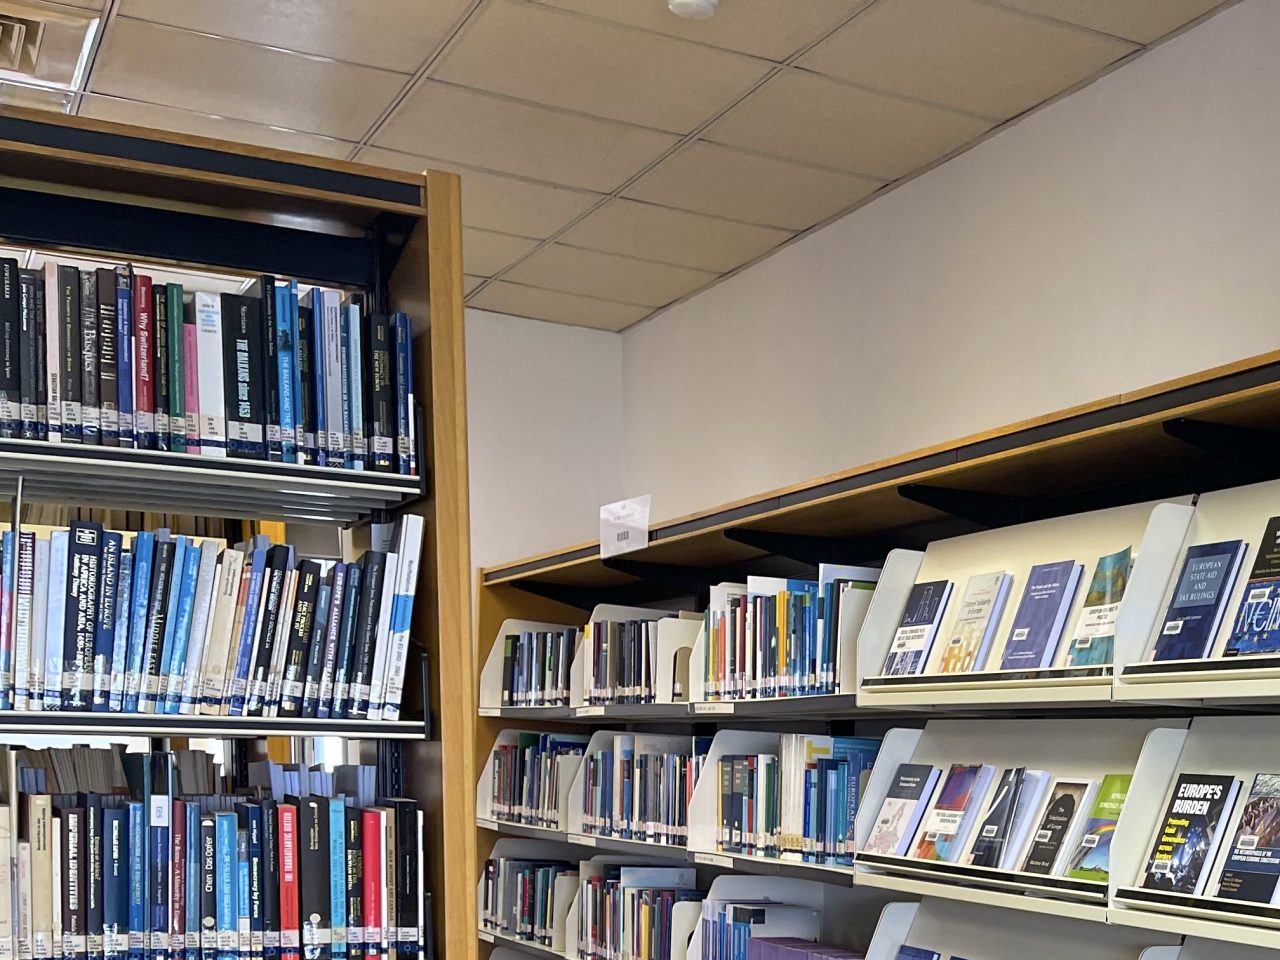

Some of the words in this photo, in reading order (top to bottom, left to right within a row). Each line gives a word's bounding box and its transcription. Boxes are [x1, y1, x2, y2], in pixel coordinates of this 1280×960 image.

[139, 312, 147, 330] Why
[236, 339, 248, 351] THE
[139, 331, 149, 381] Switzerland?
[236, 352, 250, 382] BALKANS
[238, 383, 249, 400] since
[239, 401, 250, 417] 1453
[1178, 784, 1223, 799] EUROPE'S
[1172, 800, 1210, 815] BURDEN
[68, 814, 78, 858] IMPERIAL
[205, 836, 214, 852] Opfer
[205, 853, 214, 867] Das
[69, 859, 78, 910] IDENTITIES
[205, 872, 214, 892] Chen
